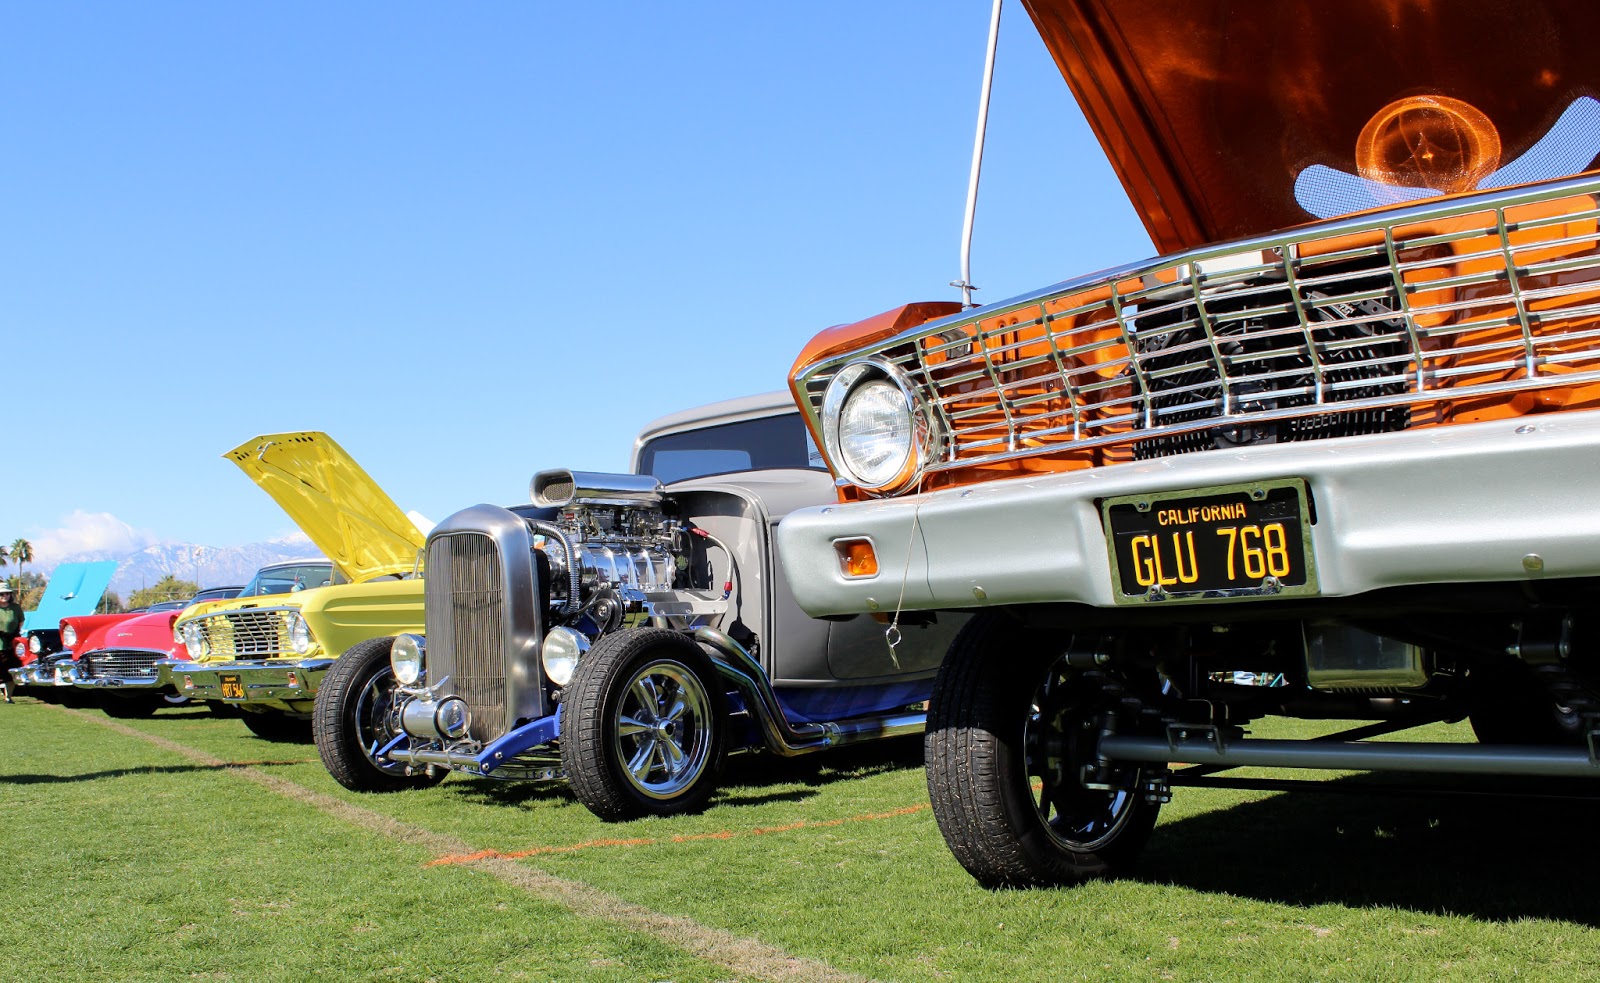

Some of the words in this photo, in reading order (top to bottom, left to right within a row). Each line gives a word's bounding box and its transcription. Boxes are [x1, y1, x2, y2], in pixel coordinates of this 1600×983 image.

[1158, 502, 1247, 526] CALIFORNIA
[1131, 530, 1199, 587] GLU
[1216, 523, 1290, 581] 768
